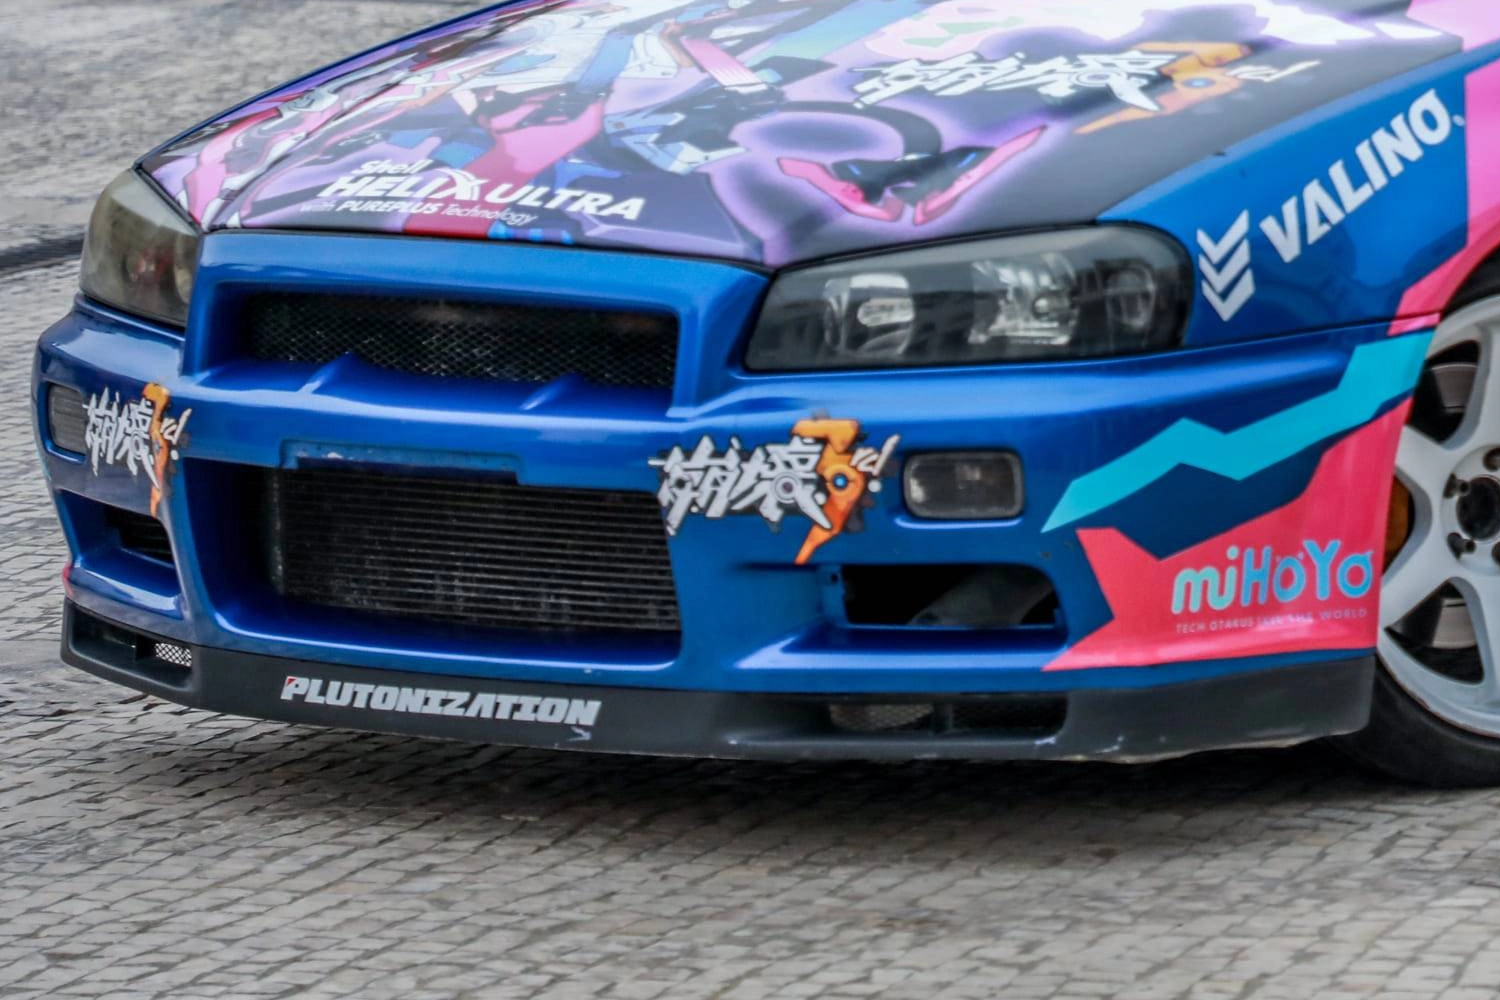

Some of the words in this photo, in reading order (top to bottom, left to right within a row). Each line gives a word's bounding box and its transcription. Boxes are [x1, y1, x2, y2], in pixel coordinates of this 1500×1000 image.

[352, 159, 434, 177] Shell
[1258, 89, 1452, 263] VALINO
[316, 167, 488, 201] HELIX
[485, 183, 646, 221] ULTRA
[336, 200, 442, 215] PUREPLUS
[440, 203, 540, 227] Technology
[1171, 540, 1374, 615] miHoYo
[1176, 619, 1205, 634] TECH
[281, 676, 601, 727] PLUTONIZATION
